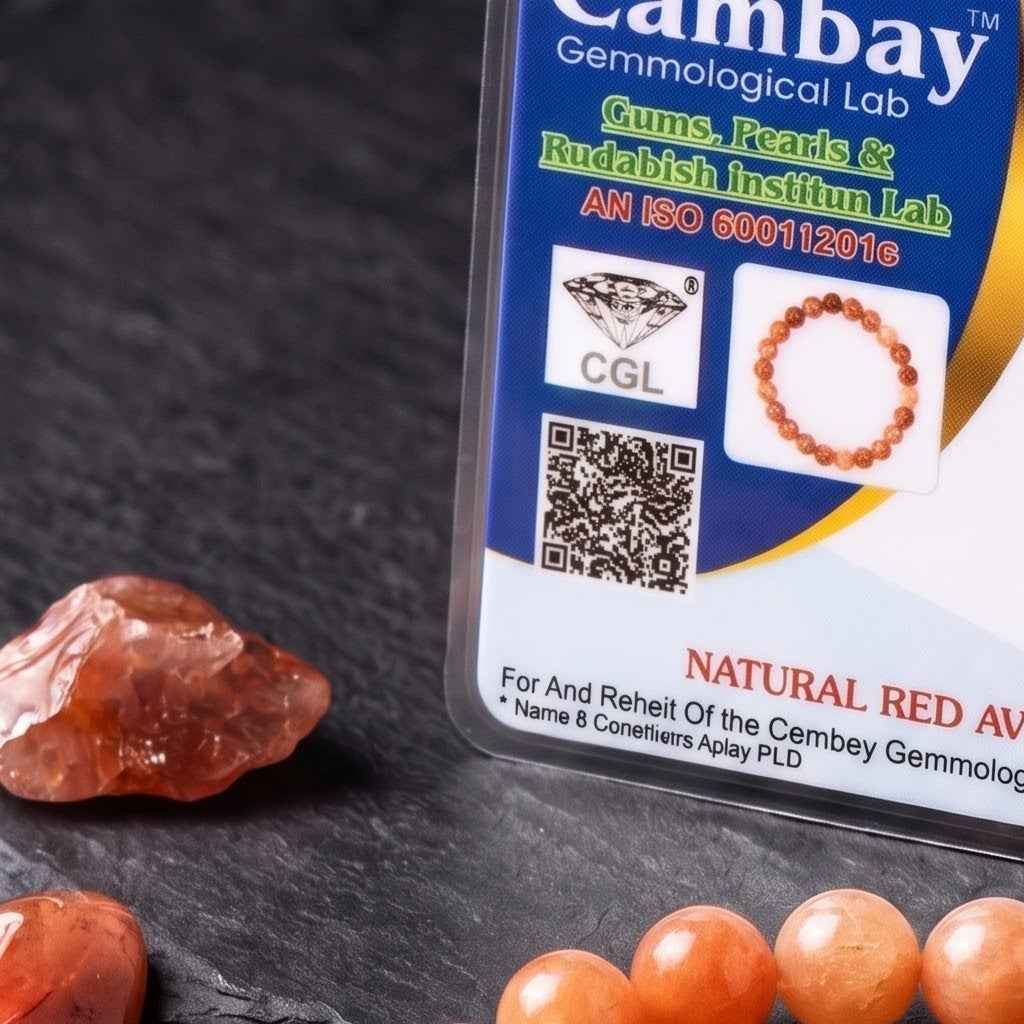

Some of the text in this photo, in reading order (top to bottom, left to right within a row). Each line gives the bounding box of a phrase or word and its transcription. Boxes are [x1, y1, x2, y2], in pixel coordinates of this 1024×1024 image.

[557, 35, 909, 118] Gemmological Lab
[602, 95, 895, 173] Gums, Pearls &
[539, 131, 952, 230] Rudabish institun Lab
[580, 186, 633, 223] AN
[642, 195, 703, 234] ISO
[581, 352, 664, 395] CGL
[501, 666, 540, 694] For
[546, 676, 592, 704] And
[600, 685, 677, 721] Reheit
[684, 701, 714, 726] Of
[722, 709, 759, 736] the
[768, 717, 878, 764] Cembey
[685, 648, 868, 712] NATURAL
[880, 685, 963, 728] RED
[515, 698, 570, 724] Name
[698, 734, 751, 764] Aplay
[758, 744, 802, 769] PLD
